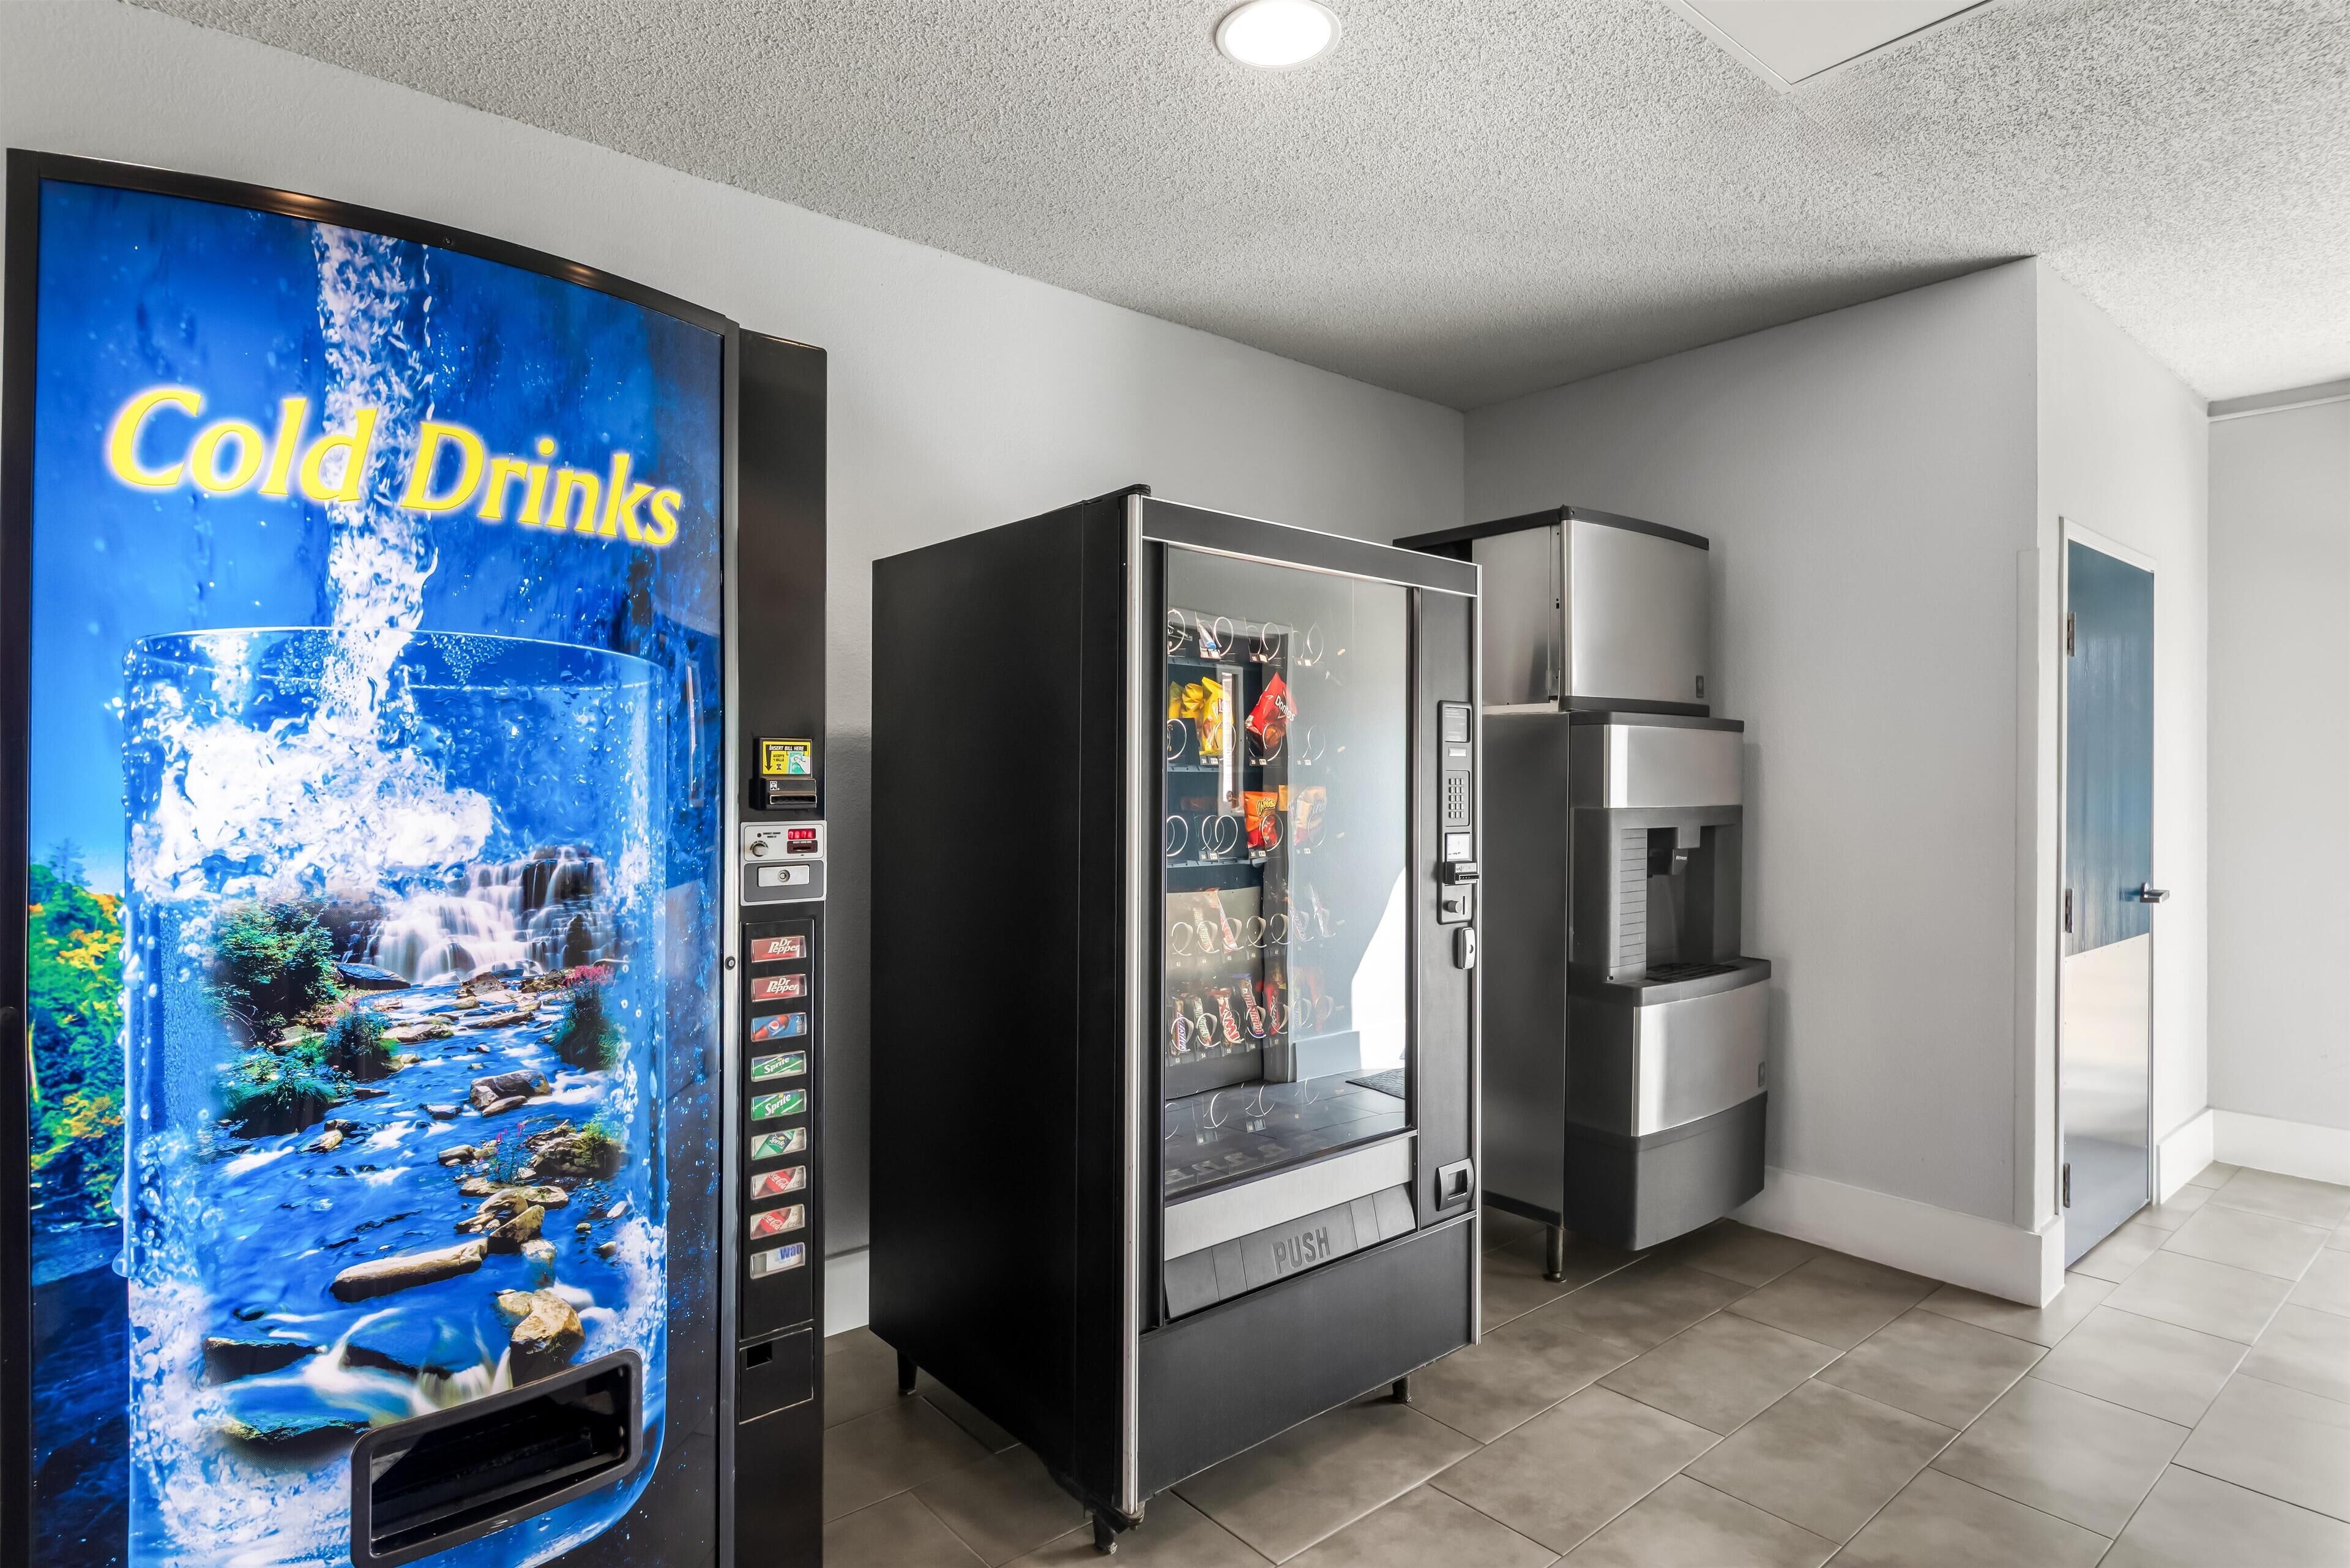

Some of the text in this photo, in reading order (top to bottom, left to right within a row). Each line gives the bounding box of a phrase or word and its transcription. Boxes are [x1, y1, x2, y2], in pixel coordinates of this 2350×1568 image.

[111, 389, 681, 546] Cold Drinks
[1275, 695, 1295, 722] Doritos
[768, 941, 800, 954] Pepper
[766, 980, 799, 994] Pepper
[1218, 1002, 1240, 1039] TWIX
[764, 1057, 790, 1074] Sprite
[764, 1094, 791, 1116] Sprite
[769, 1136, 785, 1146] Sprite
[1271, 1226, 1331, 1275] PUSH
